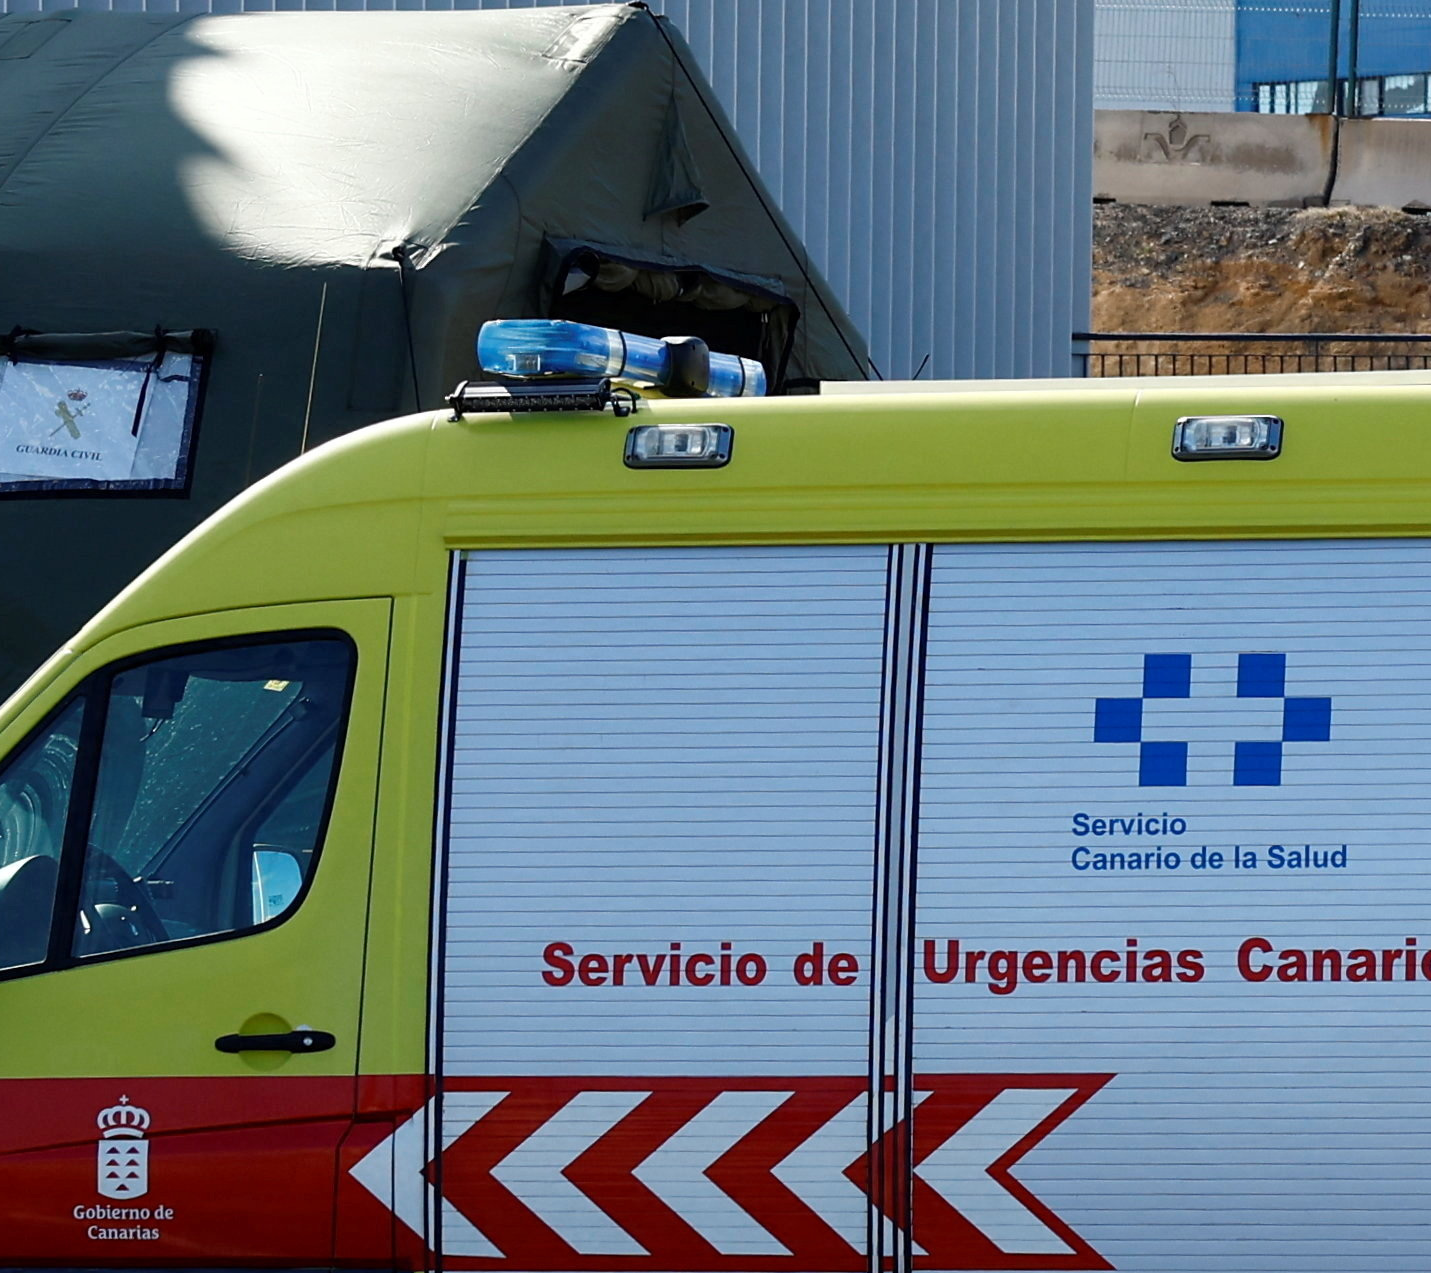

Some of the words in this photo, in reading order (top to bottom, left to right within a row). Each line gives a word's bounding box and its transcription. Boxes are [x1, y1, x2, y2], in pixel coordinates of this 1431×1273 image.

[16, 444, 68, 457] GUARDIA
[70, 449, 103, 461] CIVIL
[1070, 810, 1189, 838] Servicio
[1071, 845, 1185, 872] Canario
[1189, 845, 1225, 871] de
[1233, 844, 1262, 870] la
[1265, 843, 1350, 871] Salud
[543, 942, 766, 986] Servicio
[795, 943, 858, 985] de
[925, 939, 1204, 995] Urgencias
[73, 1202, 151, 1221] Gobierno
[153, 1204, 174, 1221] de
[87, 1225, 160, 1241] Canarias
